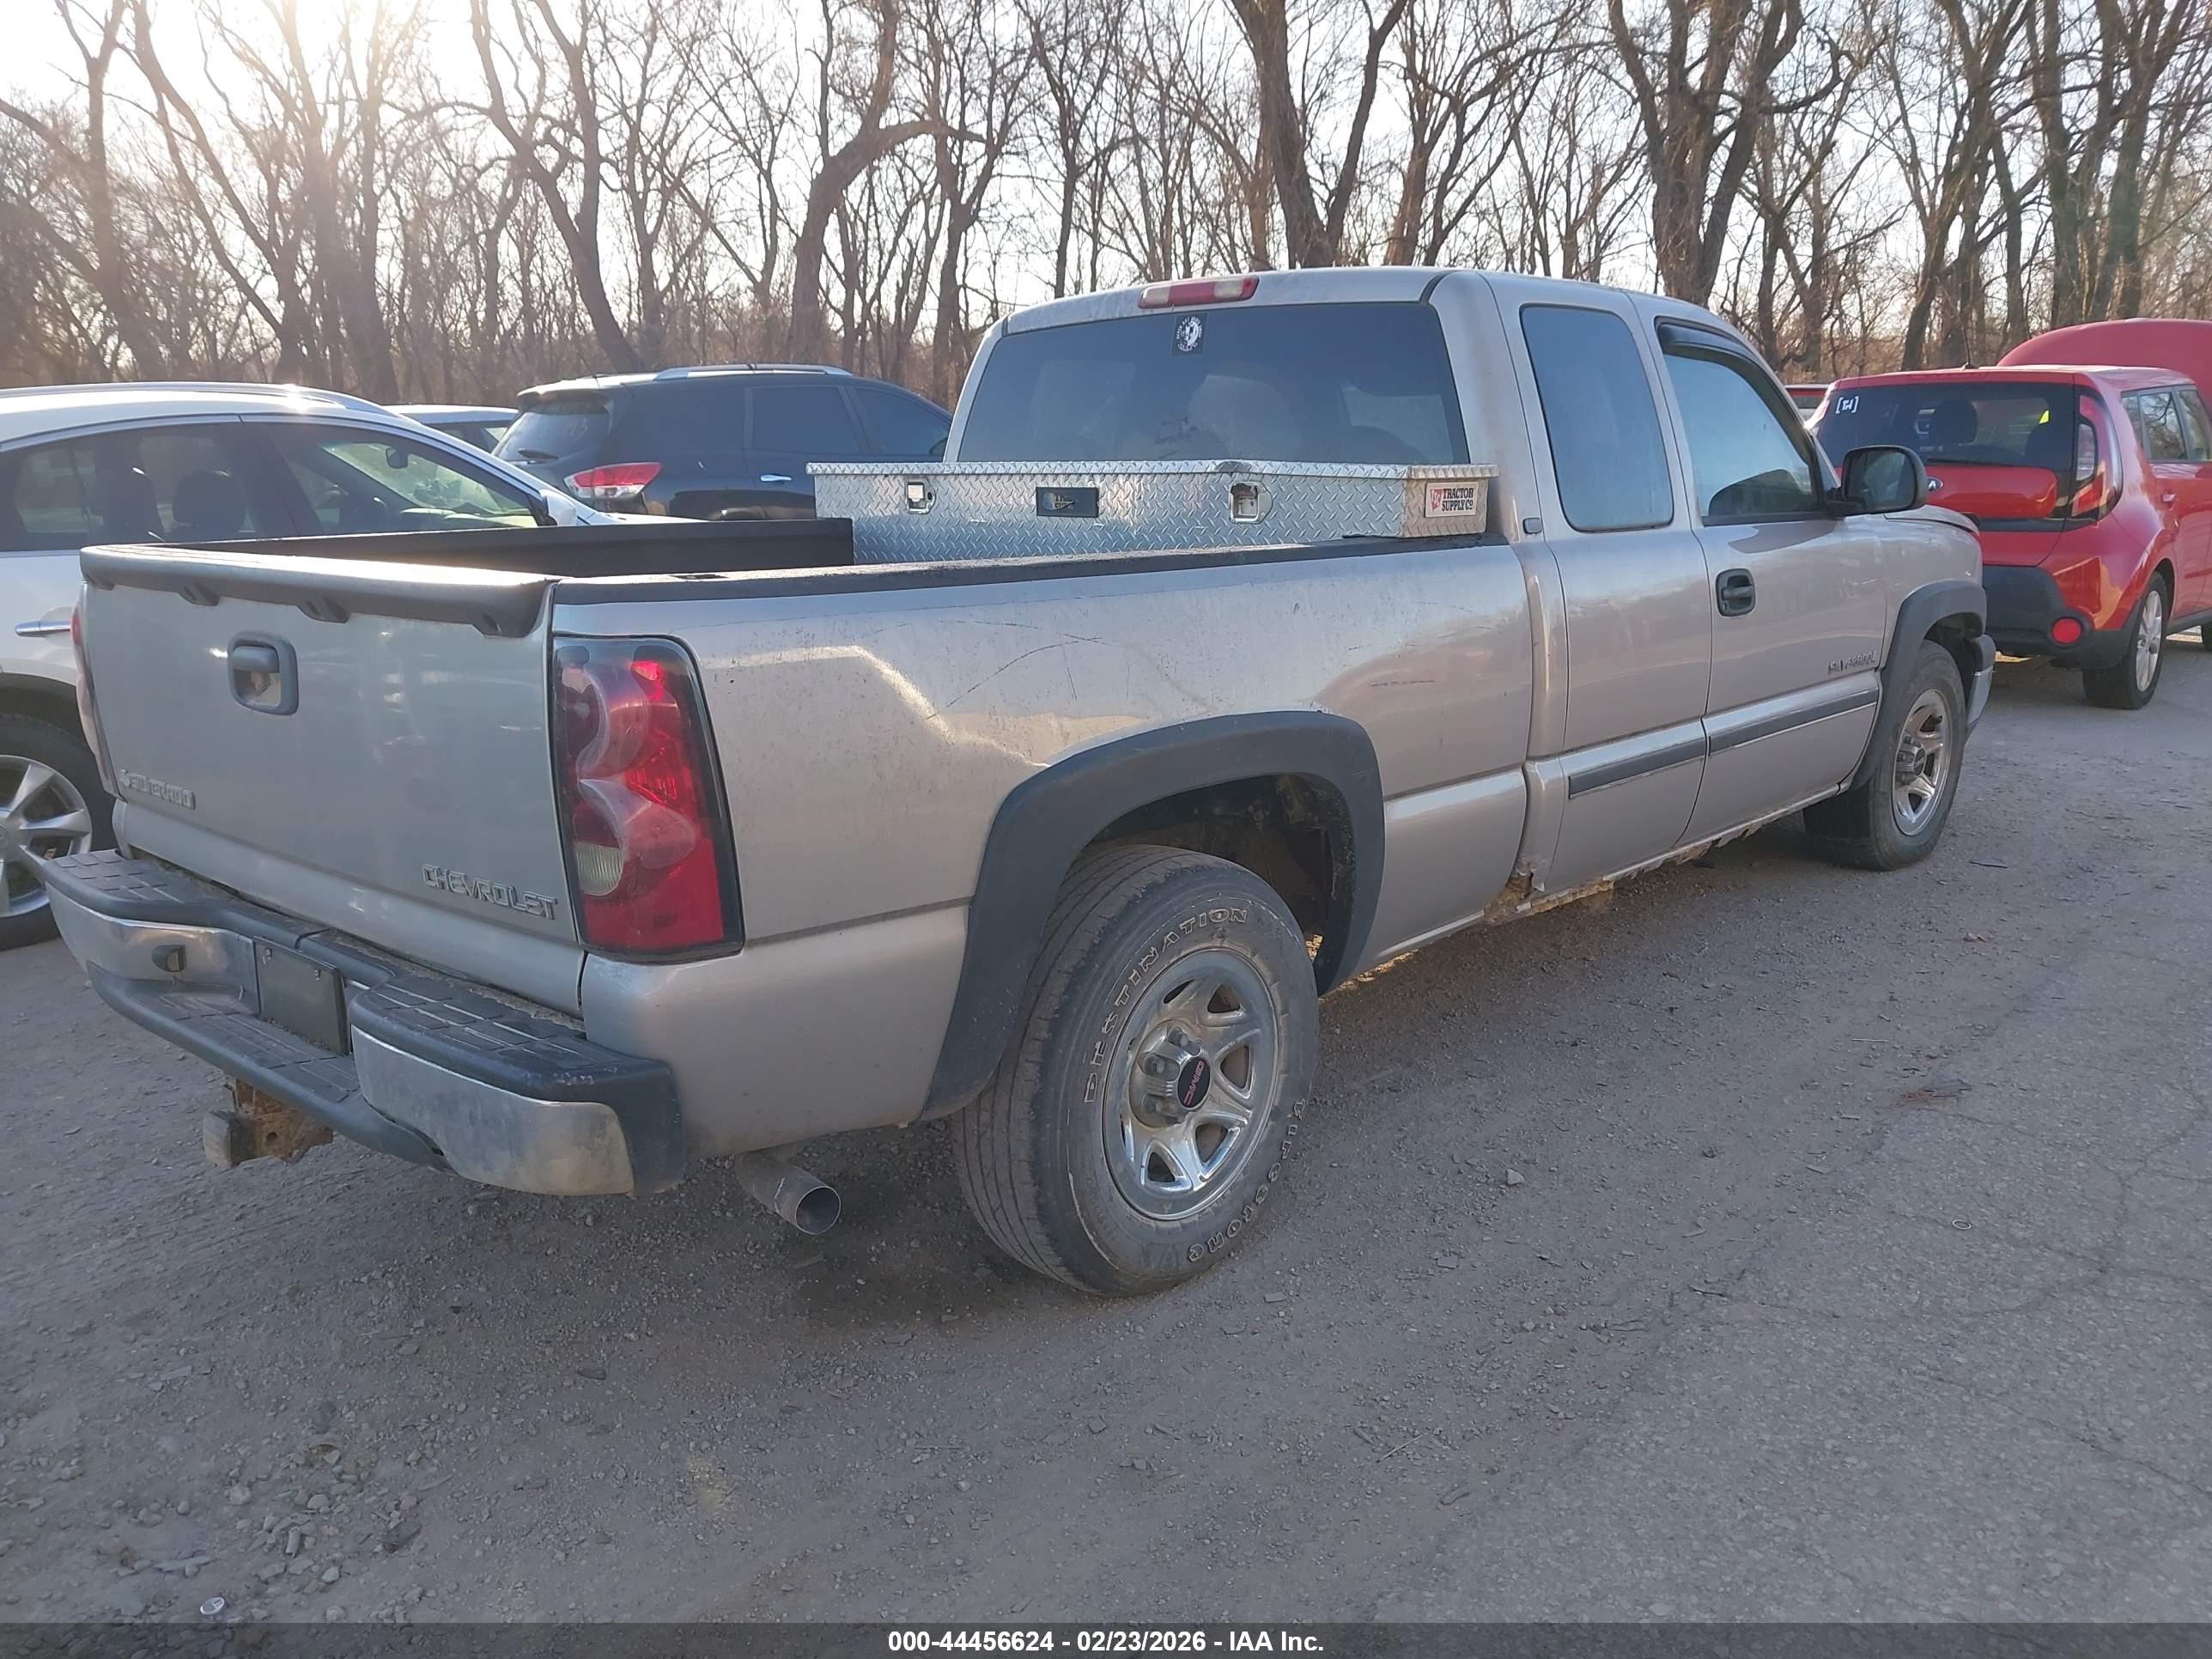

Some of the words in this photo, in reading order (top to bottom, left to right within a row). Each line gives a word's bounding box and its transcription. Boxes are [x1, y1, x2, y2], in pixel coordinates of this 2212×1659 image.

[1442, 500, 1466, 511] SUPPLY
[1443, 487, 1474, 499] TRACTOR
[422, 864, 558, 921] CHEVROLET
[1084, 907, 1248, 1103] DESTINATION
[1183, 1060, 1205, 1106] GMC
